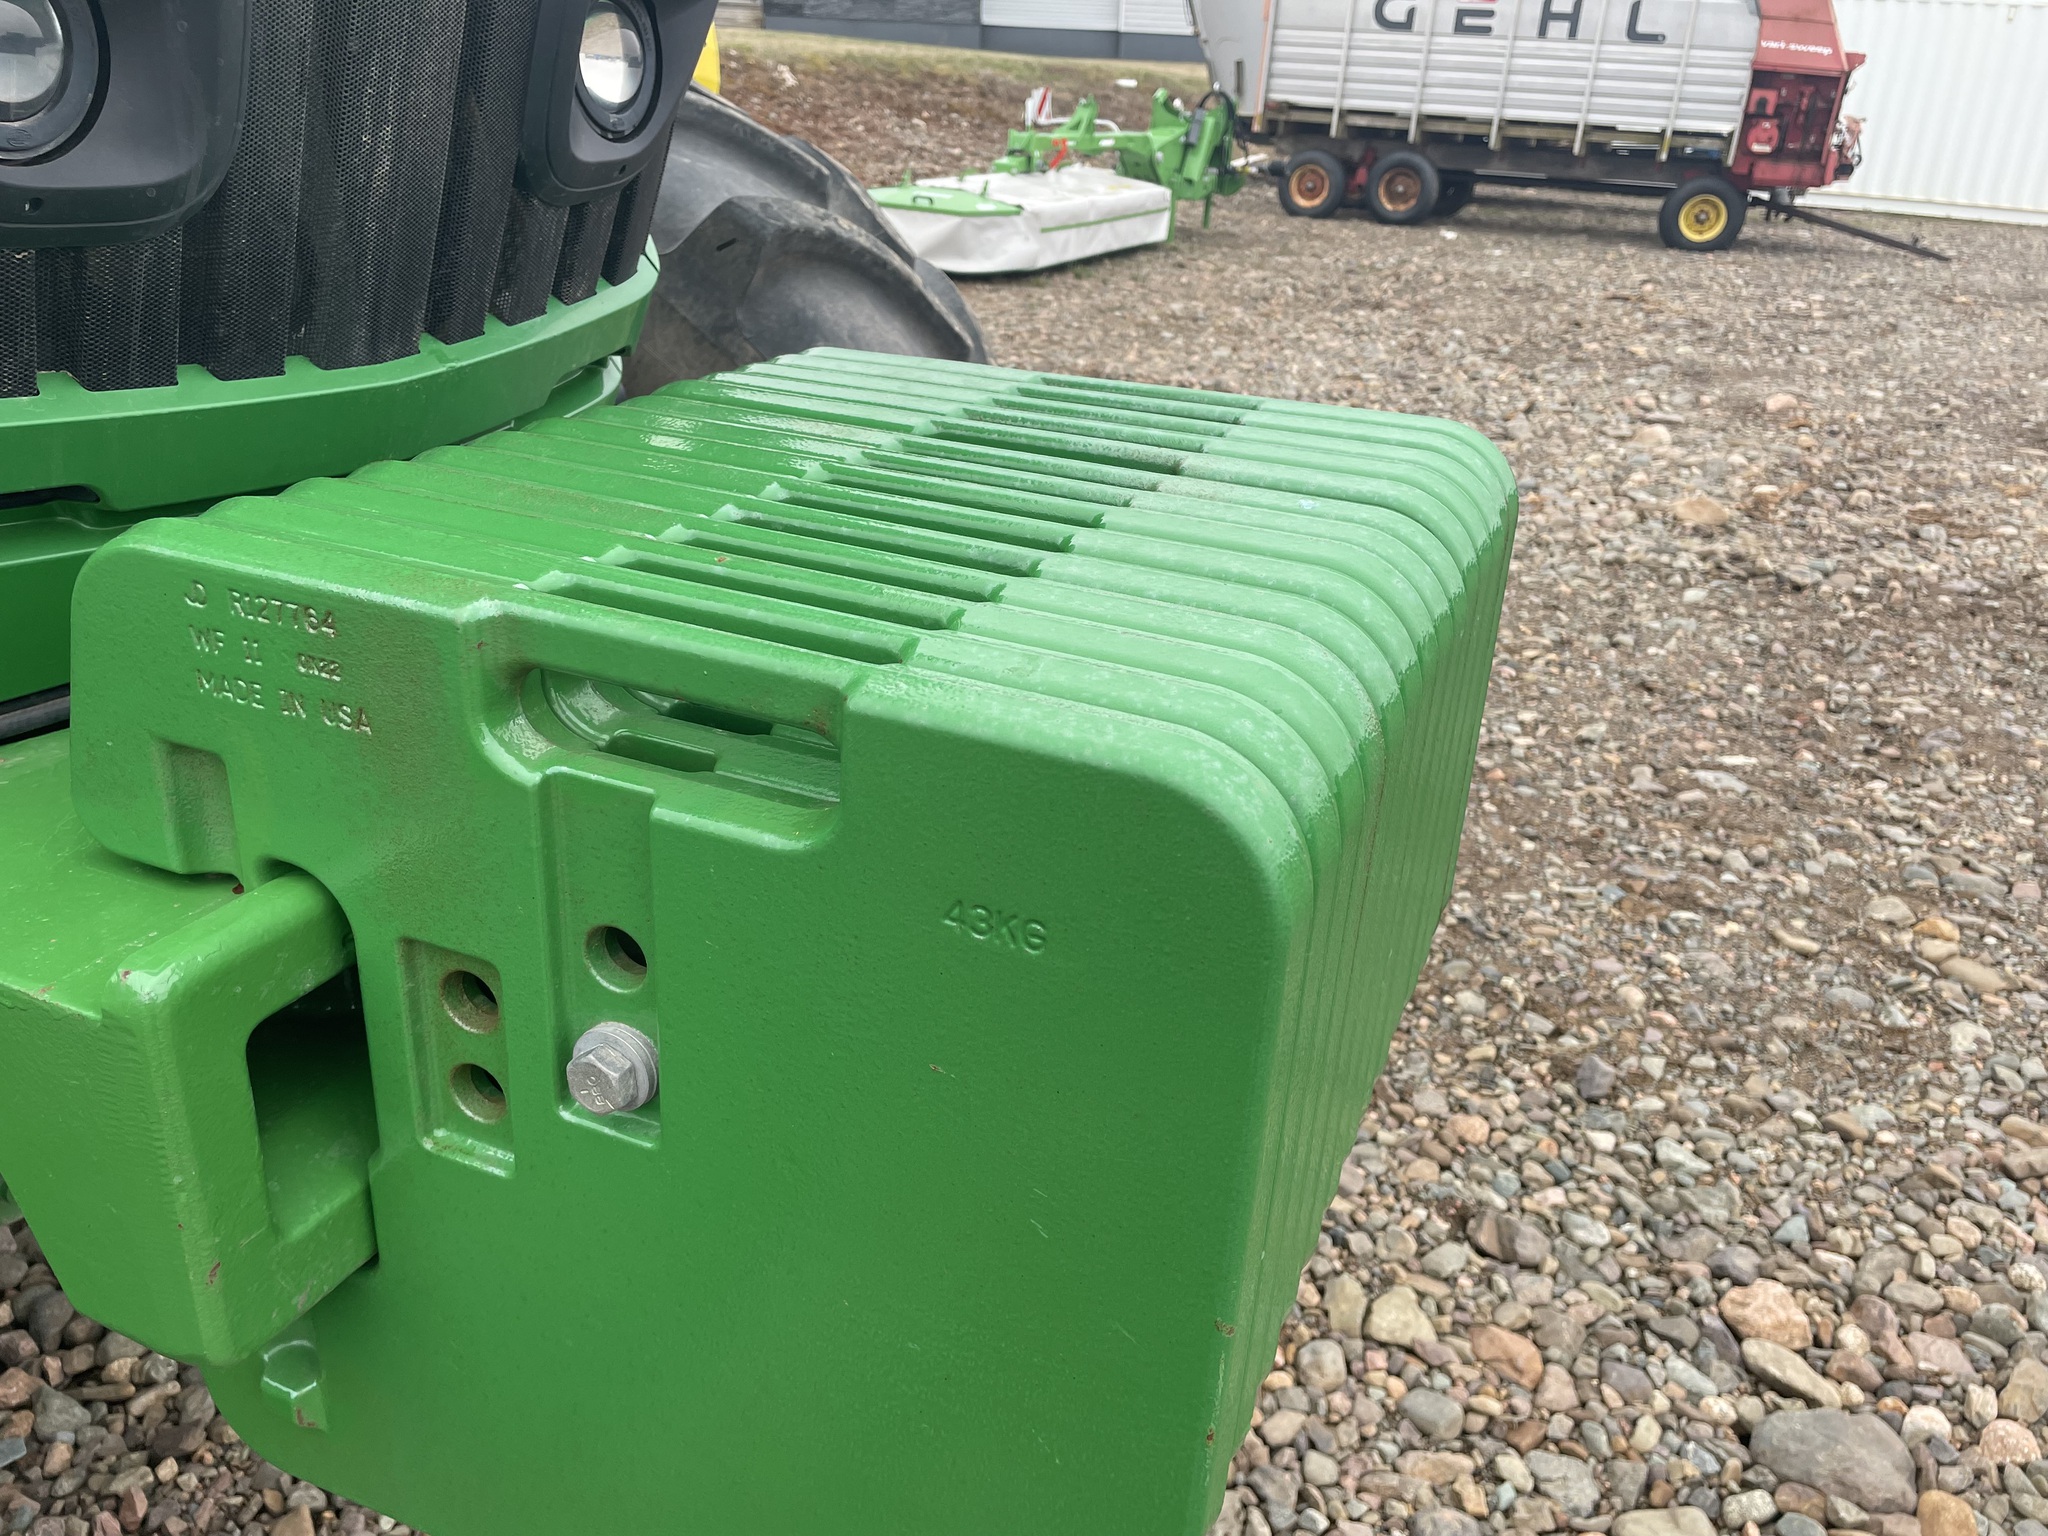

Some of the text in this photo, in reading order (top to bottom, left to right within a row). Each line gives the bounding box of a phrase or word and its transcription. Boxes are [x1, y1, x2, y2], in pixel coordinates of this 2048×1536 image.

[1374, 0, 1667, 43] GEHL
[189, 623, 225, 655] WF
[196, 668, 373, 735] MADE IN USA
[941, 899, 1048, 956] 43KG
